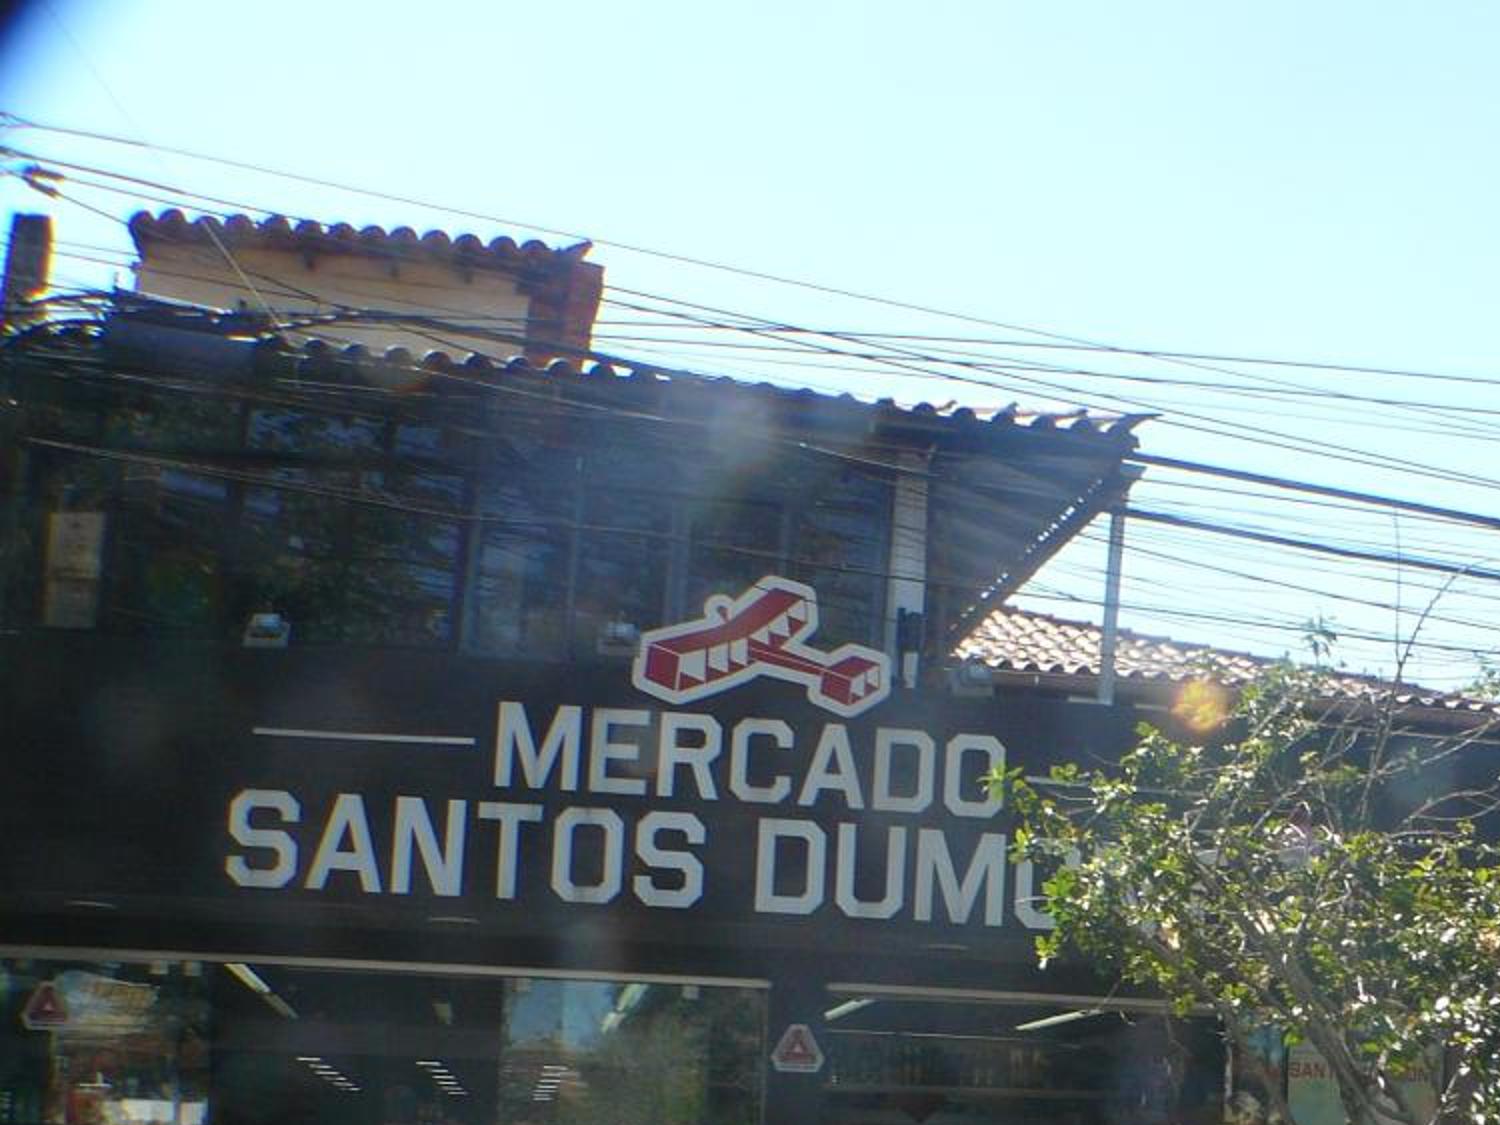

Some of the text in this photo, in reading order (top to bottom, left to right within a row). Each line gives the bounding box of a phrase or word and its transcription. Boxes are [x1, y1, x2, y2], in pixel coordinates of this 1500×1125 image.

[492, 701, 1006, 818] MERCADO
[225, 789, 1083, 930] SANTOS DUMO
